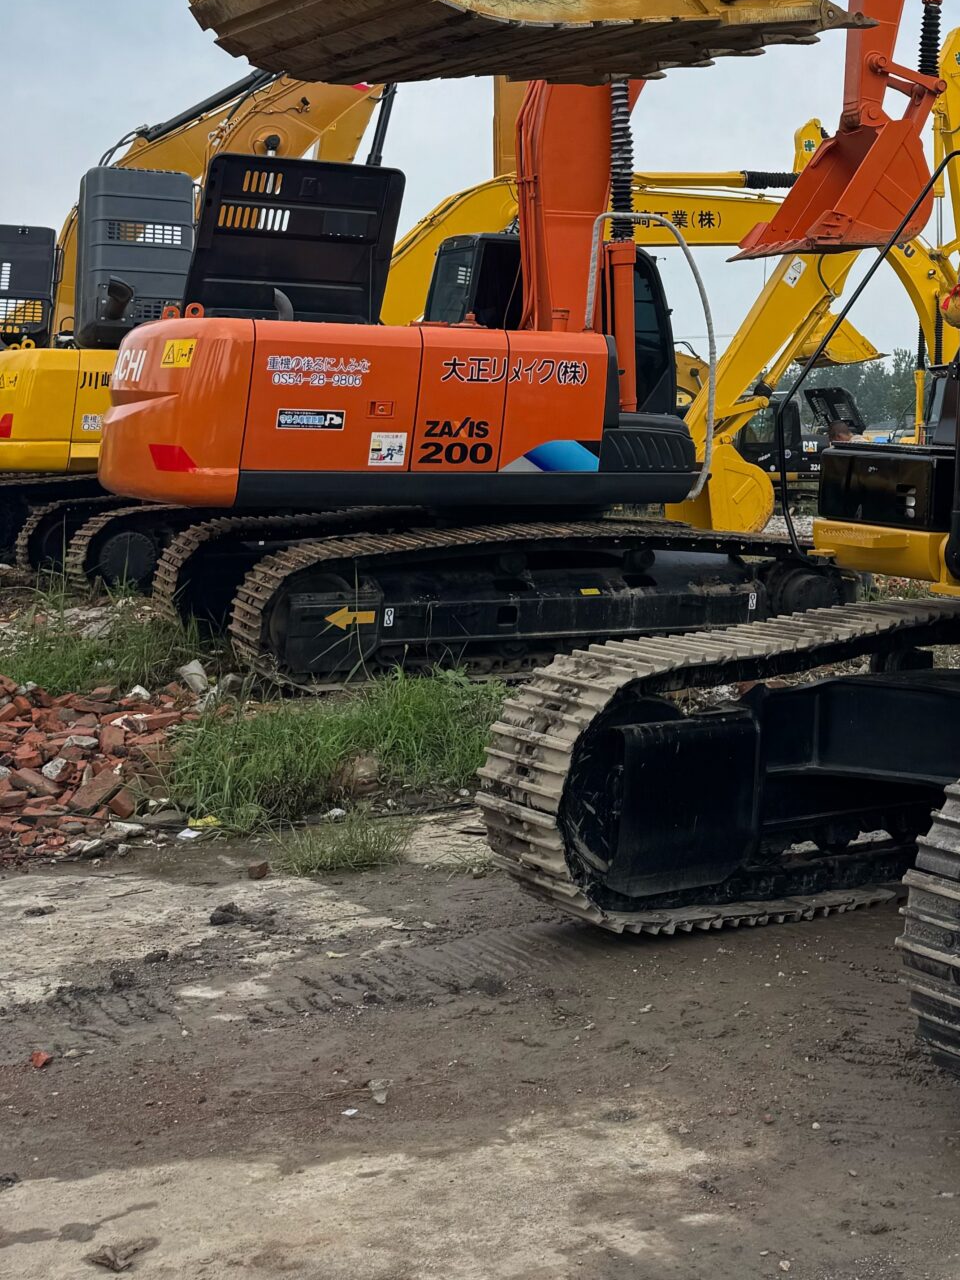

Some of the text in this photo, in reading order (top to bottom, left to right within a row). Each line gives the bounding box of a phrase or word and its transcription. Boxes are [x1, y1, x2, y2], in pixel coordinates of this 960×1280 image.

[440, 356, 589, 385] 大正リメイク(株)
[423, 416, 490, 439] ZAXIS
[417, 442, 494, 465] 200
[802, 441, 818, 452] CAT
